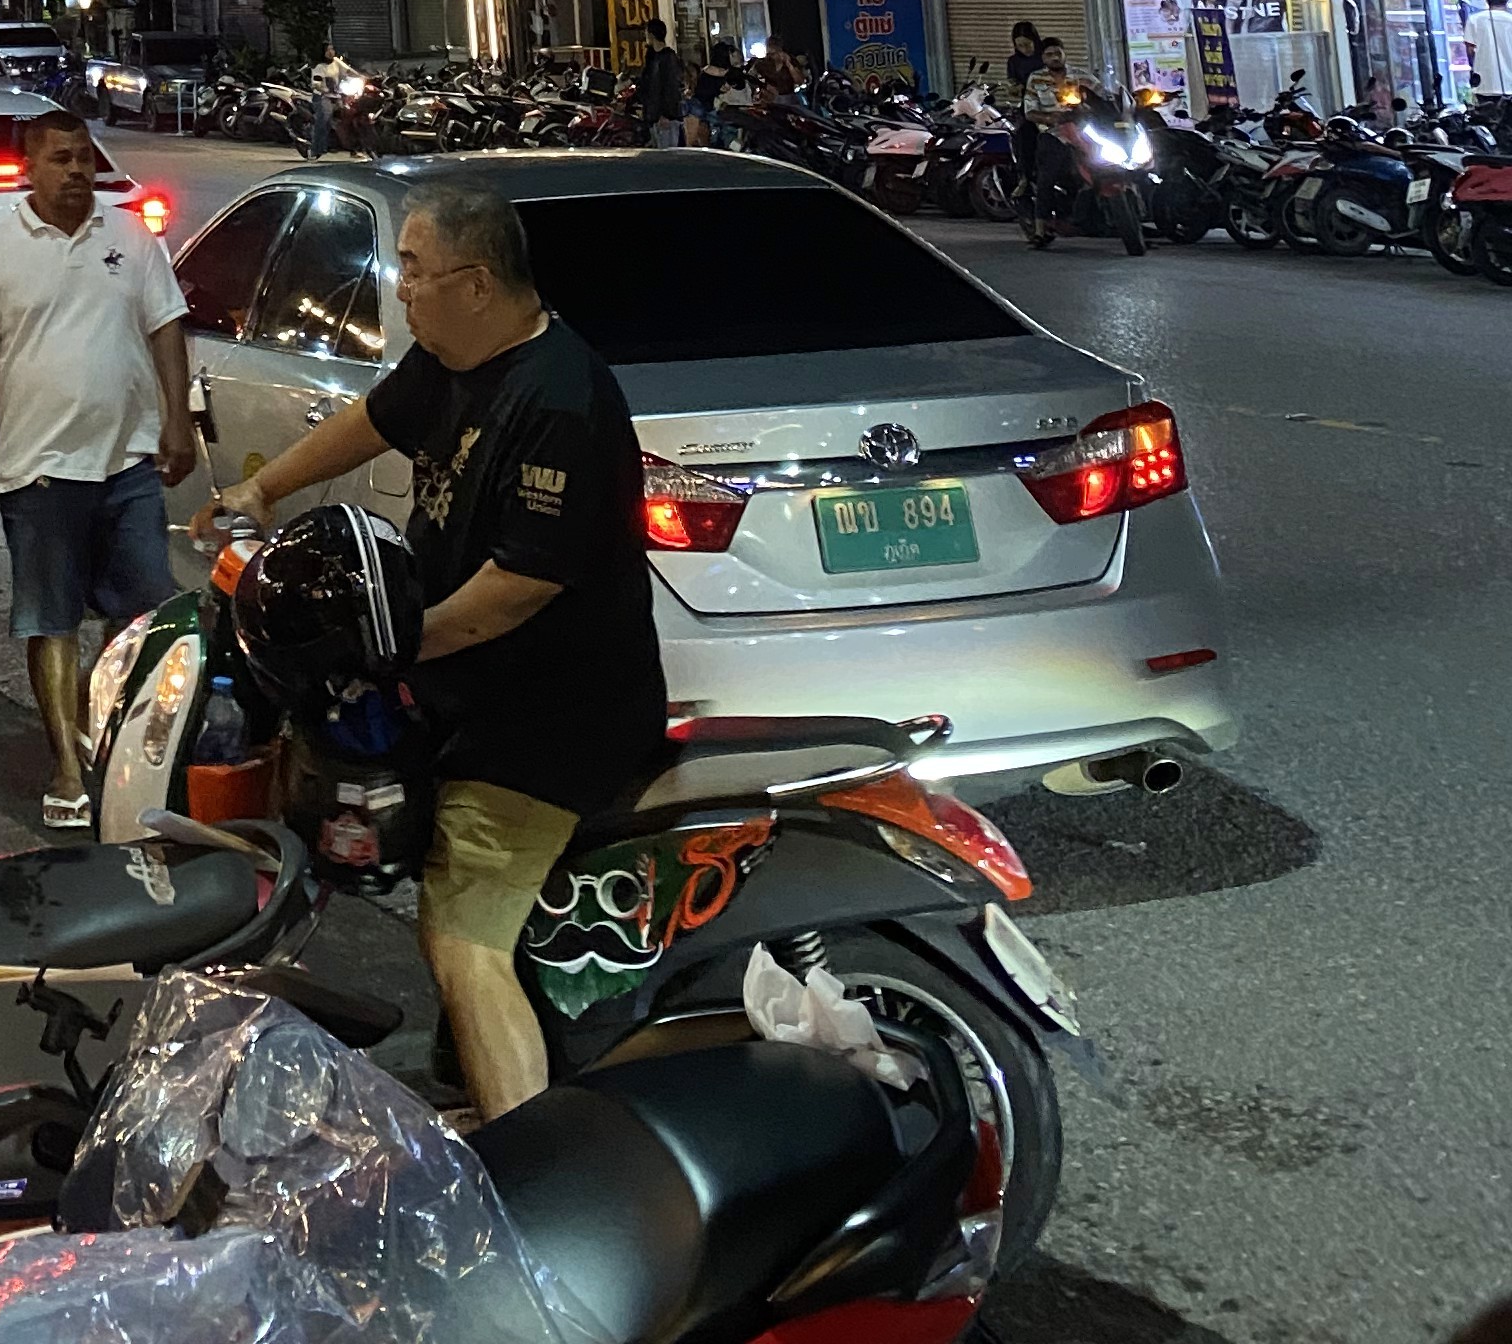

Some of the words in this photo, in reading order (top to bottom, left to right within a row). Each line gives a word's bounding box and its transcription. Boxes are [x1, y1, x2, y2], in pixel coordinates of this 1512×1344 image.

[521, 463, 567, 494] WU
[517, 487, 563, 507] Western
[526, 499, 561, 517] Union
[903, 494, 955, 529] 894
